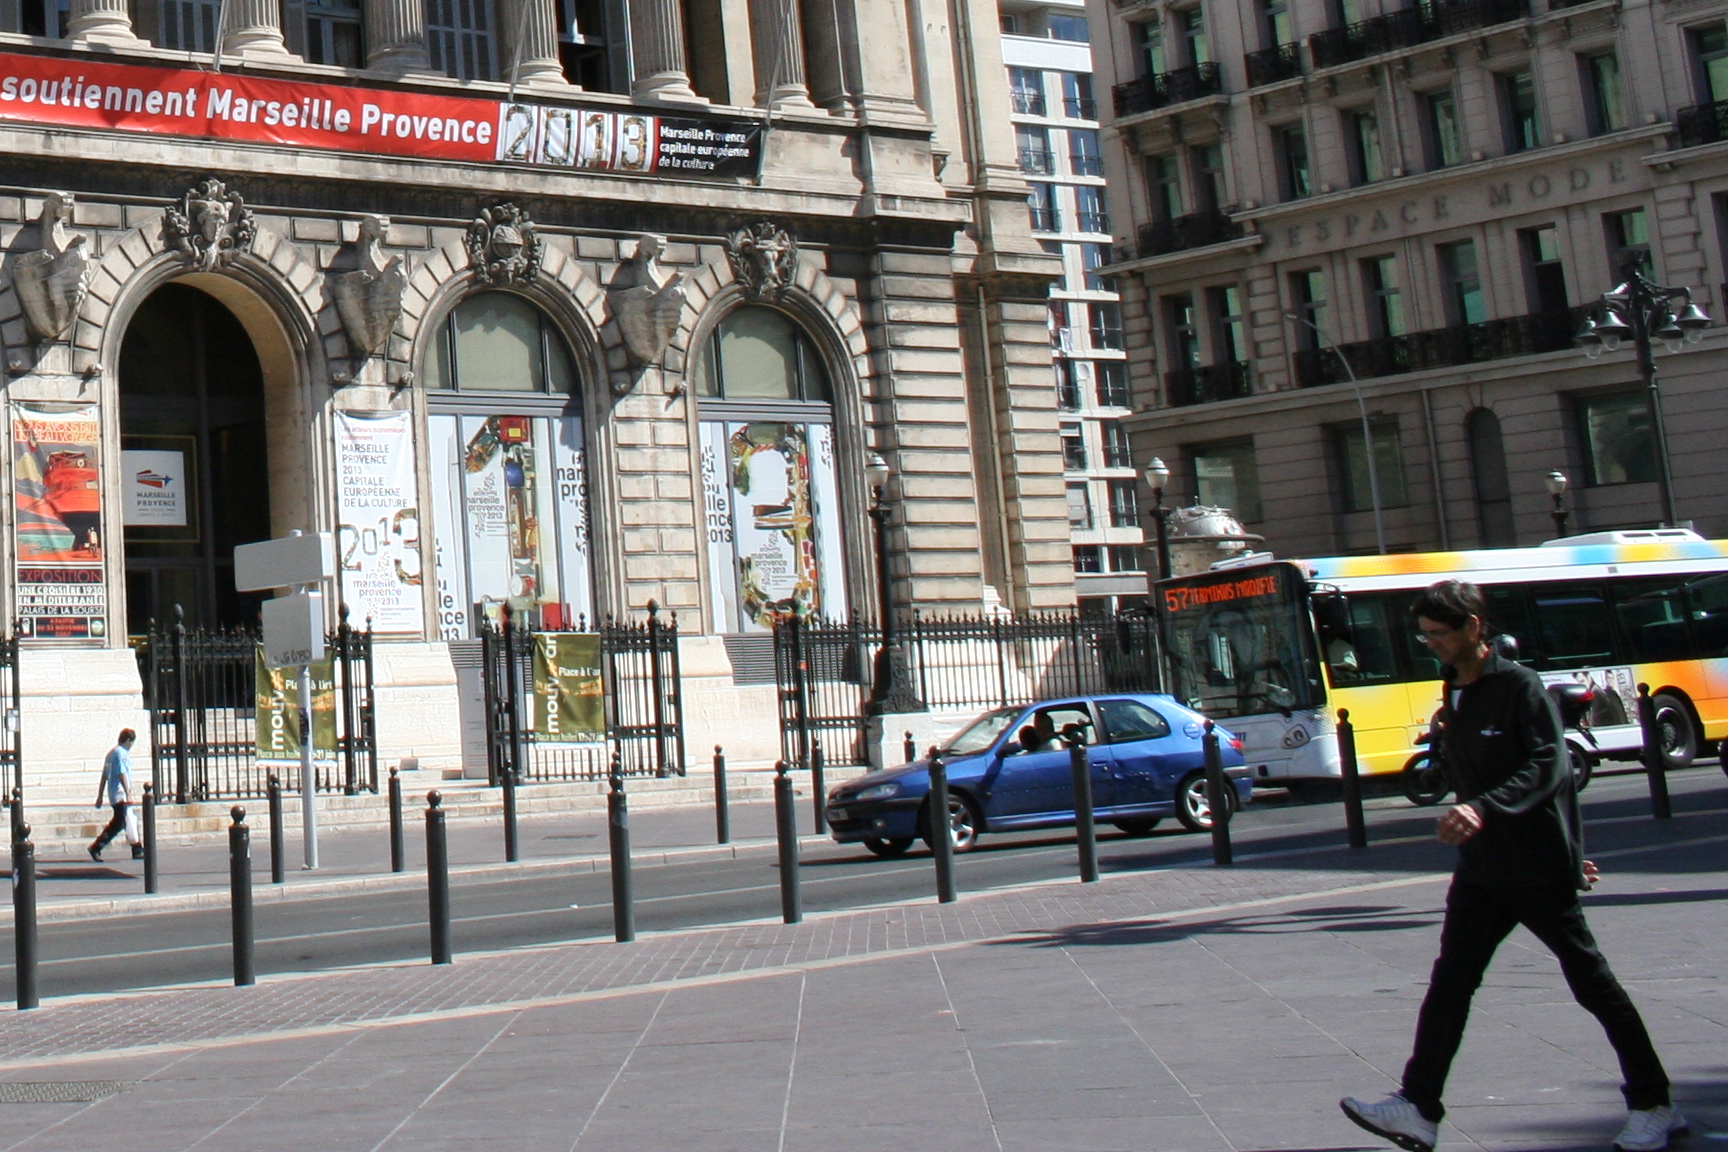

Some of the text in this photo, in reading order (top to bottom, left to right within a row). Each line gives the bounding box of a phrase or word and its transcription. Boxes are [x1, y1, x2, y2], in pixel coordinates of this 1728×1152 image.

[1, 71, 196, 120] soutiennent
[206, 87, 351, 134] Marseille
[360, 103, 492, 146] Provence
[504, 104, 647, 170] 2013
[660, 125, 746, 143] Marseille Provence
[659, 142, 750, 158] capitale européenne
[658, 156, 715, 170] de la culture
[1287, 158, 1627, 249] ESPACE MODE
[342, 444, 389, 453] MARSEILLE
[342, 455, 387, 464] PROVENCE
[343, 465, 362, 474] 2013
[343, 476, 384, 486] CAPITALE
[345, 499, 408, 508] DE LA CULTURE
[19, 570, 102, 583] EXPOSITION
[353, 579, 397, 588] marseille
[18, 586, 36, 594] UNE
[18, 596, 31, 605] EN
[1164, 587, 1188, 612] 57
[1189, 582, 1235, 604] TERMINUS
[19, 606, 103, 615] PALAIS DE LA BOURSE
[558, 667, 578, 676] Place
[547, 676, 560, 733] mouv
[271, 689, 285, 750] mouv
